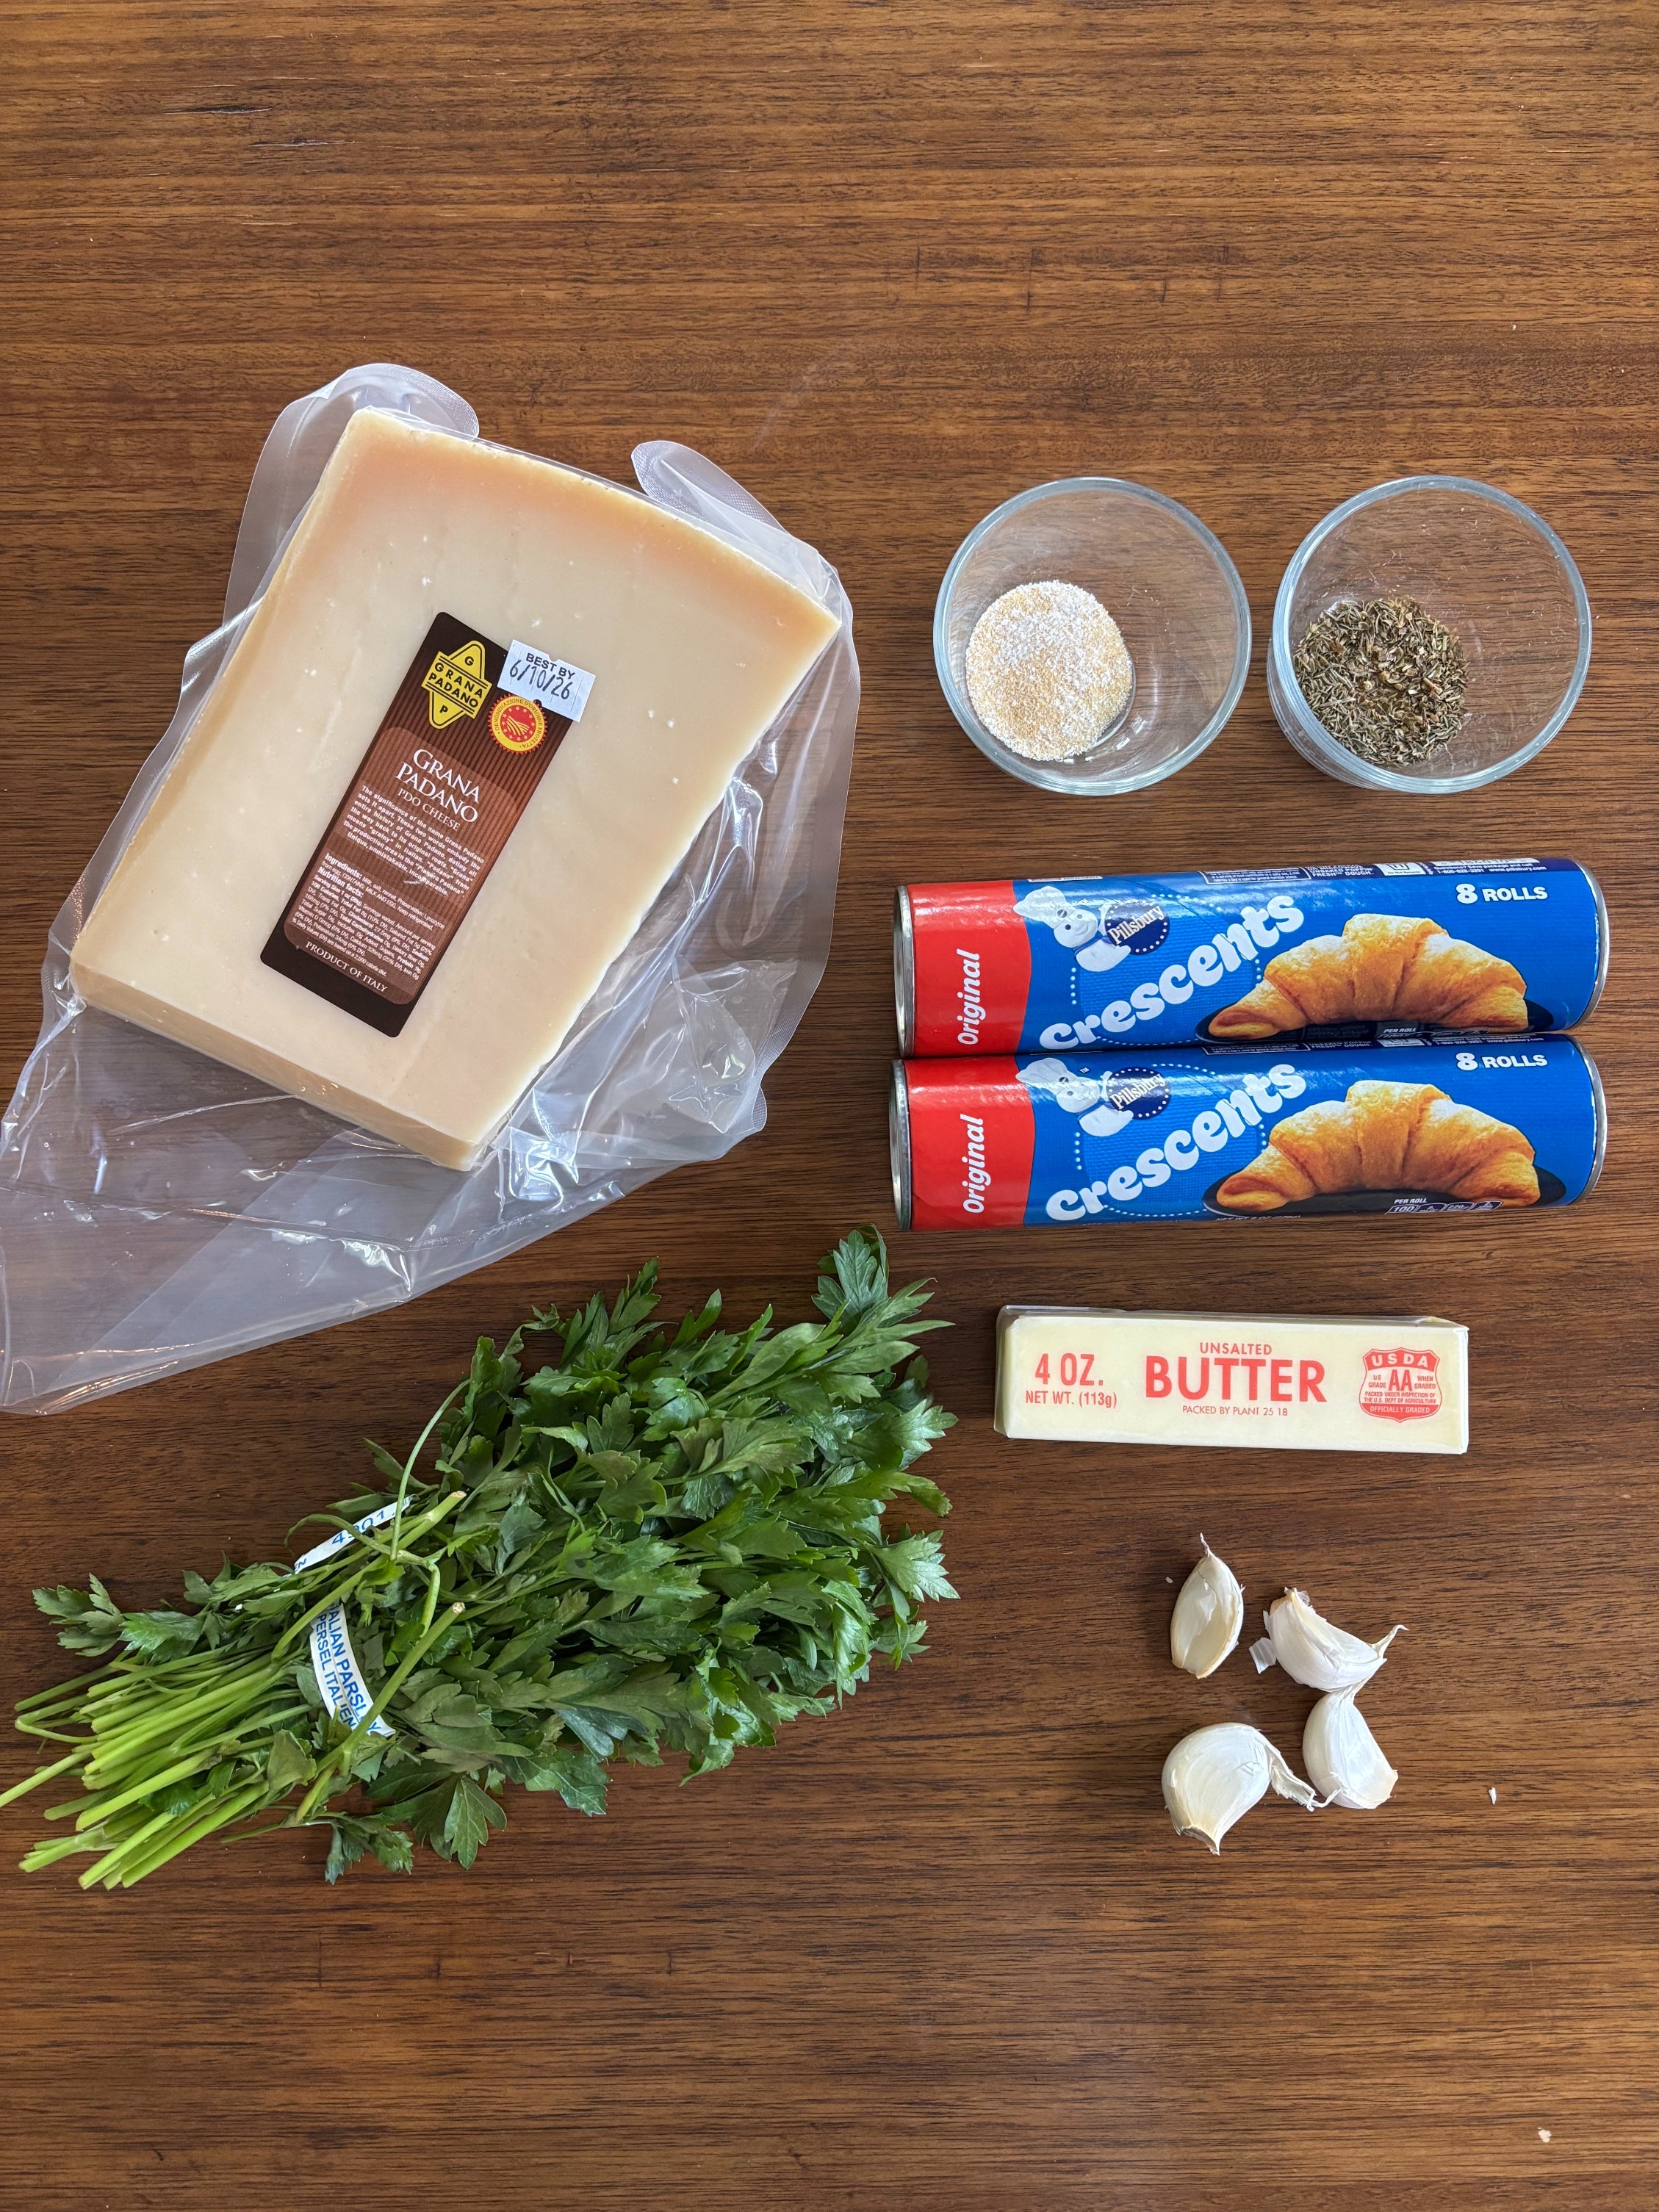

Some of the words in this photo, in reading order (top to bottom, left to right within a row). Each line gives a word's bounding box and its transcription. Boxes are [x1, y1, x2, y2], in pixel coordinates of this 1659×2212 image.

[464, 656, 475, 667] G
[510, 660, 572, 699] 6/10/26
[526, 653, 557, 671] BEST
[558, 667, 575, 680] BY
[428, 674, 479, 710] PADANO
[435, 662, 483, 699] GRANA
[439, 705, 449, 715] P
[494, 698, 524, 730] DENOMINAZIONE
[524, 699, 542, 724] D'ORIGINE
[522, 727, 542, 748] PROTETTA
[395, 763, 479, 824] PADANO
[397, 788, 420, 806] PDO
[422, 804, 460, 830] CHEESE
[347, 832, 368, 849] Unique,
[350, 806, 361, 815] the
[361, 814, 374, 824] way
[375, 821, 389, 832] back
[398, 835, 407, 843] its
[408, 842, 431, 857] original
[431, 856, 447, 869] roots.
[354, 800, 371, 813] entire
[373, 810, 394, 826] history
[404, 830, 421, 843] Grana
[423, 841, 445, 859] Padano,
[448, 857, 467, 871] dating
[358, 793, 370, 803] sets
[378, 805, 395, 818] apart.
[397, 815, 414, 829] These
[415, 827, 426, 837] two
[428, 836, 445, 849] words
[447, 848, 469, 863] embody
[470, 861, 480, 870] the
[361, 785, 373, 795] The
[373, 793, 408, 817] significance
[417, 819, 426, 828] the
[428, 826, 443, 839] name
[445, 836, 461, 850] Grana
[463, 847, 483, 863] Padano
[343, 820, 353, 829] the
[353, 827, 384, 848] production
[384, 846, 397, 856] area
[404, 857, 414, 865] the
[347, 814, 366, 827] means
[403, 847, 422, 862] Italian.
[455, 879, 469, 890] from
[317, 866, 345, 887] Nutrition
[345, 883, 364, 898] facts:
[325, 853, 361, 879] Ingredients:
[1455, 883, 1478, 904] 8
[1483, 885, 1548, 903] ROLLS
[1107, 906, 1165, 945] Pillsbury
[306, 941, 349, 969] PRODUCT
[350, 967, 362, 977] OF
[363, 975, 387, 991] ITALY
[957, 948, 986, 1045] Original
[1455, 1052, 1478, 1071] 8
[1483, 1053, 1548, 1070] ROLLS
[1109, 1073, 1166, 1110] Pillsbury
[960, 1113, 992, 1214] Original
[1200, 1342, 1273, 1355] UNSALTED
[1371, 1352, 1428, 1368] USDA
[1034, 1353, 1051, 1385] 4
[1060, 1352, 1104, 1386] OZ.
[1145, 1355, 1328, 1402] BUTTER
[1388, 1369, 1413, 1391] AA
[1026, 1390, 1048, 1404] NET
[1053, 1391, 1074, 1405] WT.
[1079, 1391, 1118, 1408] (113g)
[1182, 1405, 1217, 1415] PACKED
[1220, 1406, 1230, 1415] BY
[1233, 1407, 1260, 1416] PLANT
[1263, 1408, 1274, 1416] 25
[1278, 1408, 1288, 1416] 18
[316, 1613, 333, 1671] PERSEL
[325, 1671, 358, 1732] ITALIEN
[337, 1658, 381, 1734] PARSLY
